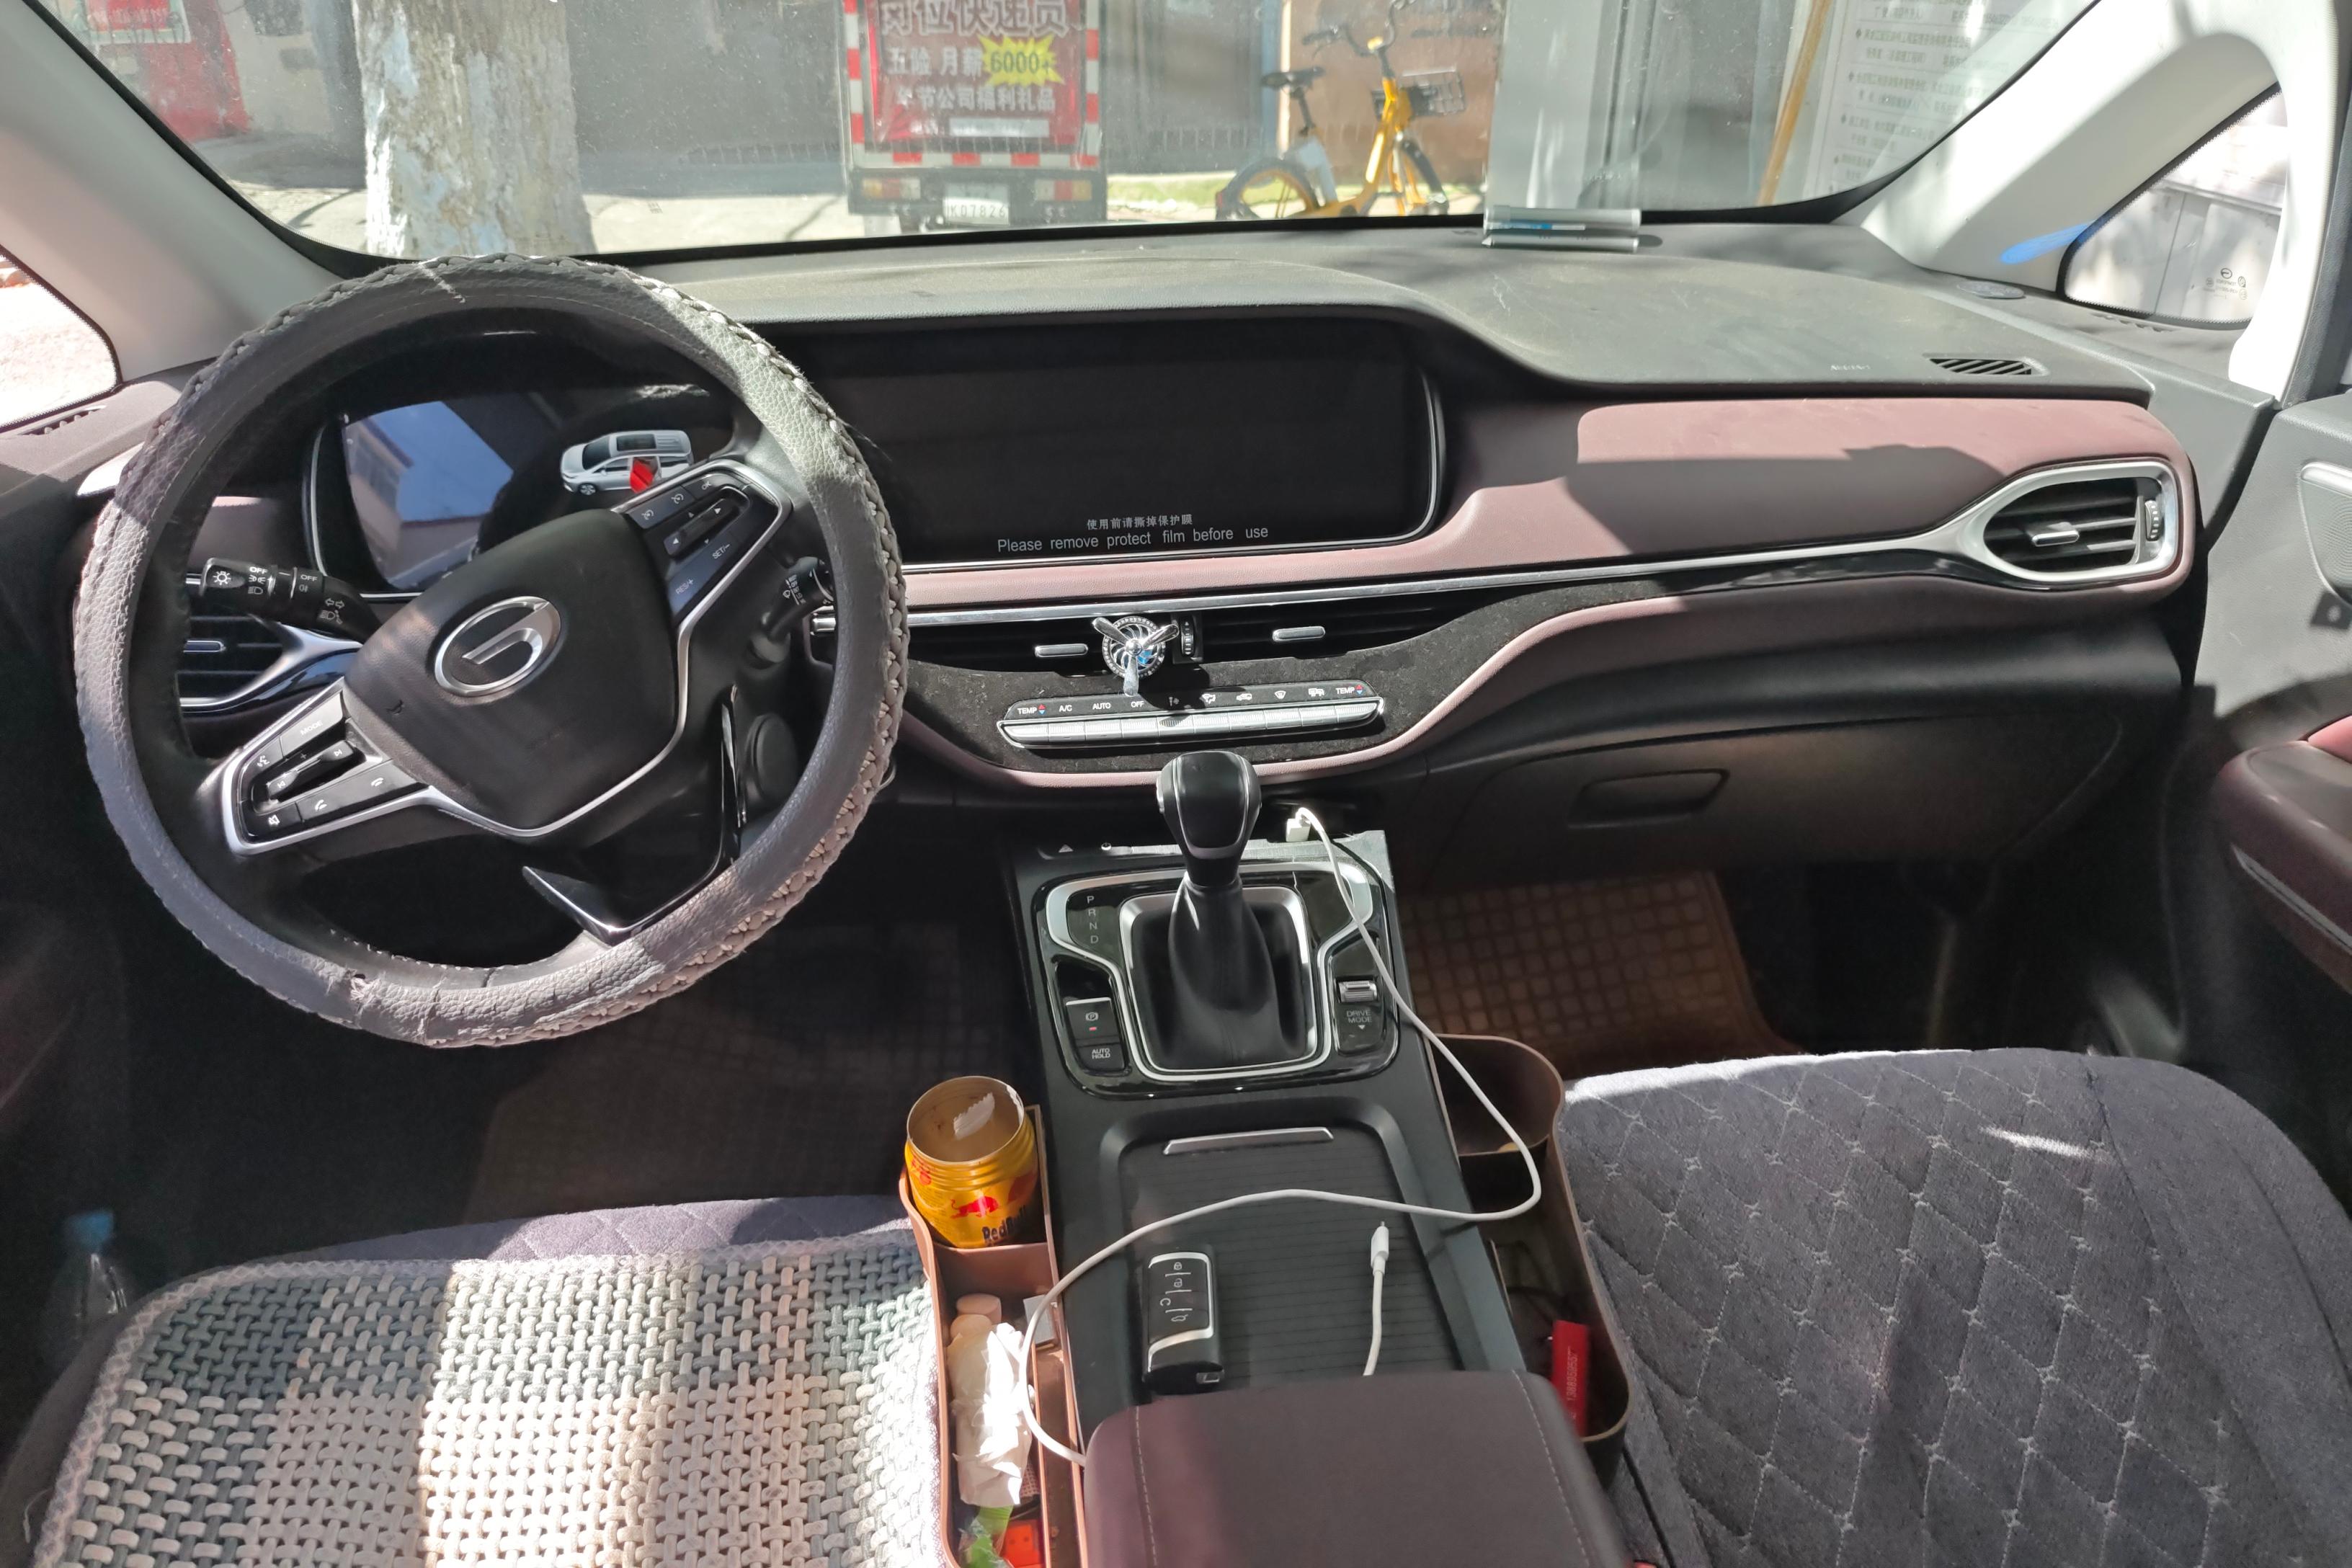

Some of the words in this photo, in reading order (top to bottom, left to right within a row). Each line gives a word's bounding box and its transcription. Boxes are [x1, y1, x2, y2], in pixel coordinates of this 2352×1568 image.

[990, 50, 1051, 75] 6000+
[1087, 514, 1193, 530] 使用前请撕掉保护膜
[997, 538, 1043, 553] Please
[1050, 536, 1099, 550] remove
[1106, 532, 1152, 550] protect
[1162, 530, 1185, 543] film
[1193, 527, 1234, 542] before
[1245, 526, 1269, 539] use
[249, 566, 269, 575] OFF
[1335, 686, 1356, 695] TEMP
[1059, 704, 1073, 713] A/C
[1092, 702, 1112, 710] AUTO
[1130, 700, 1145, 708] OFF
[1017, 706, 1038, 716] TEMP
[300, 721, 324, 736] MODE
[1087, 896, 1095, 904] P
[1090, 935, 1099, 944] D
